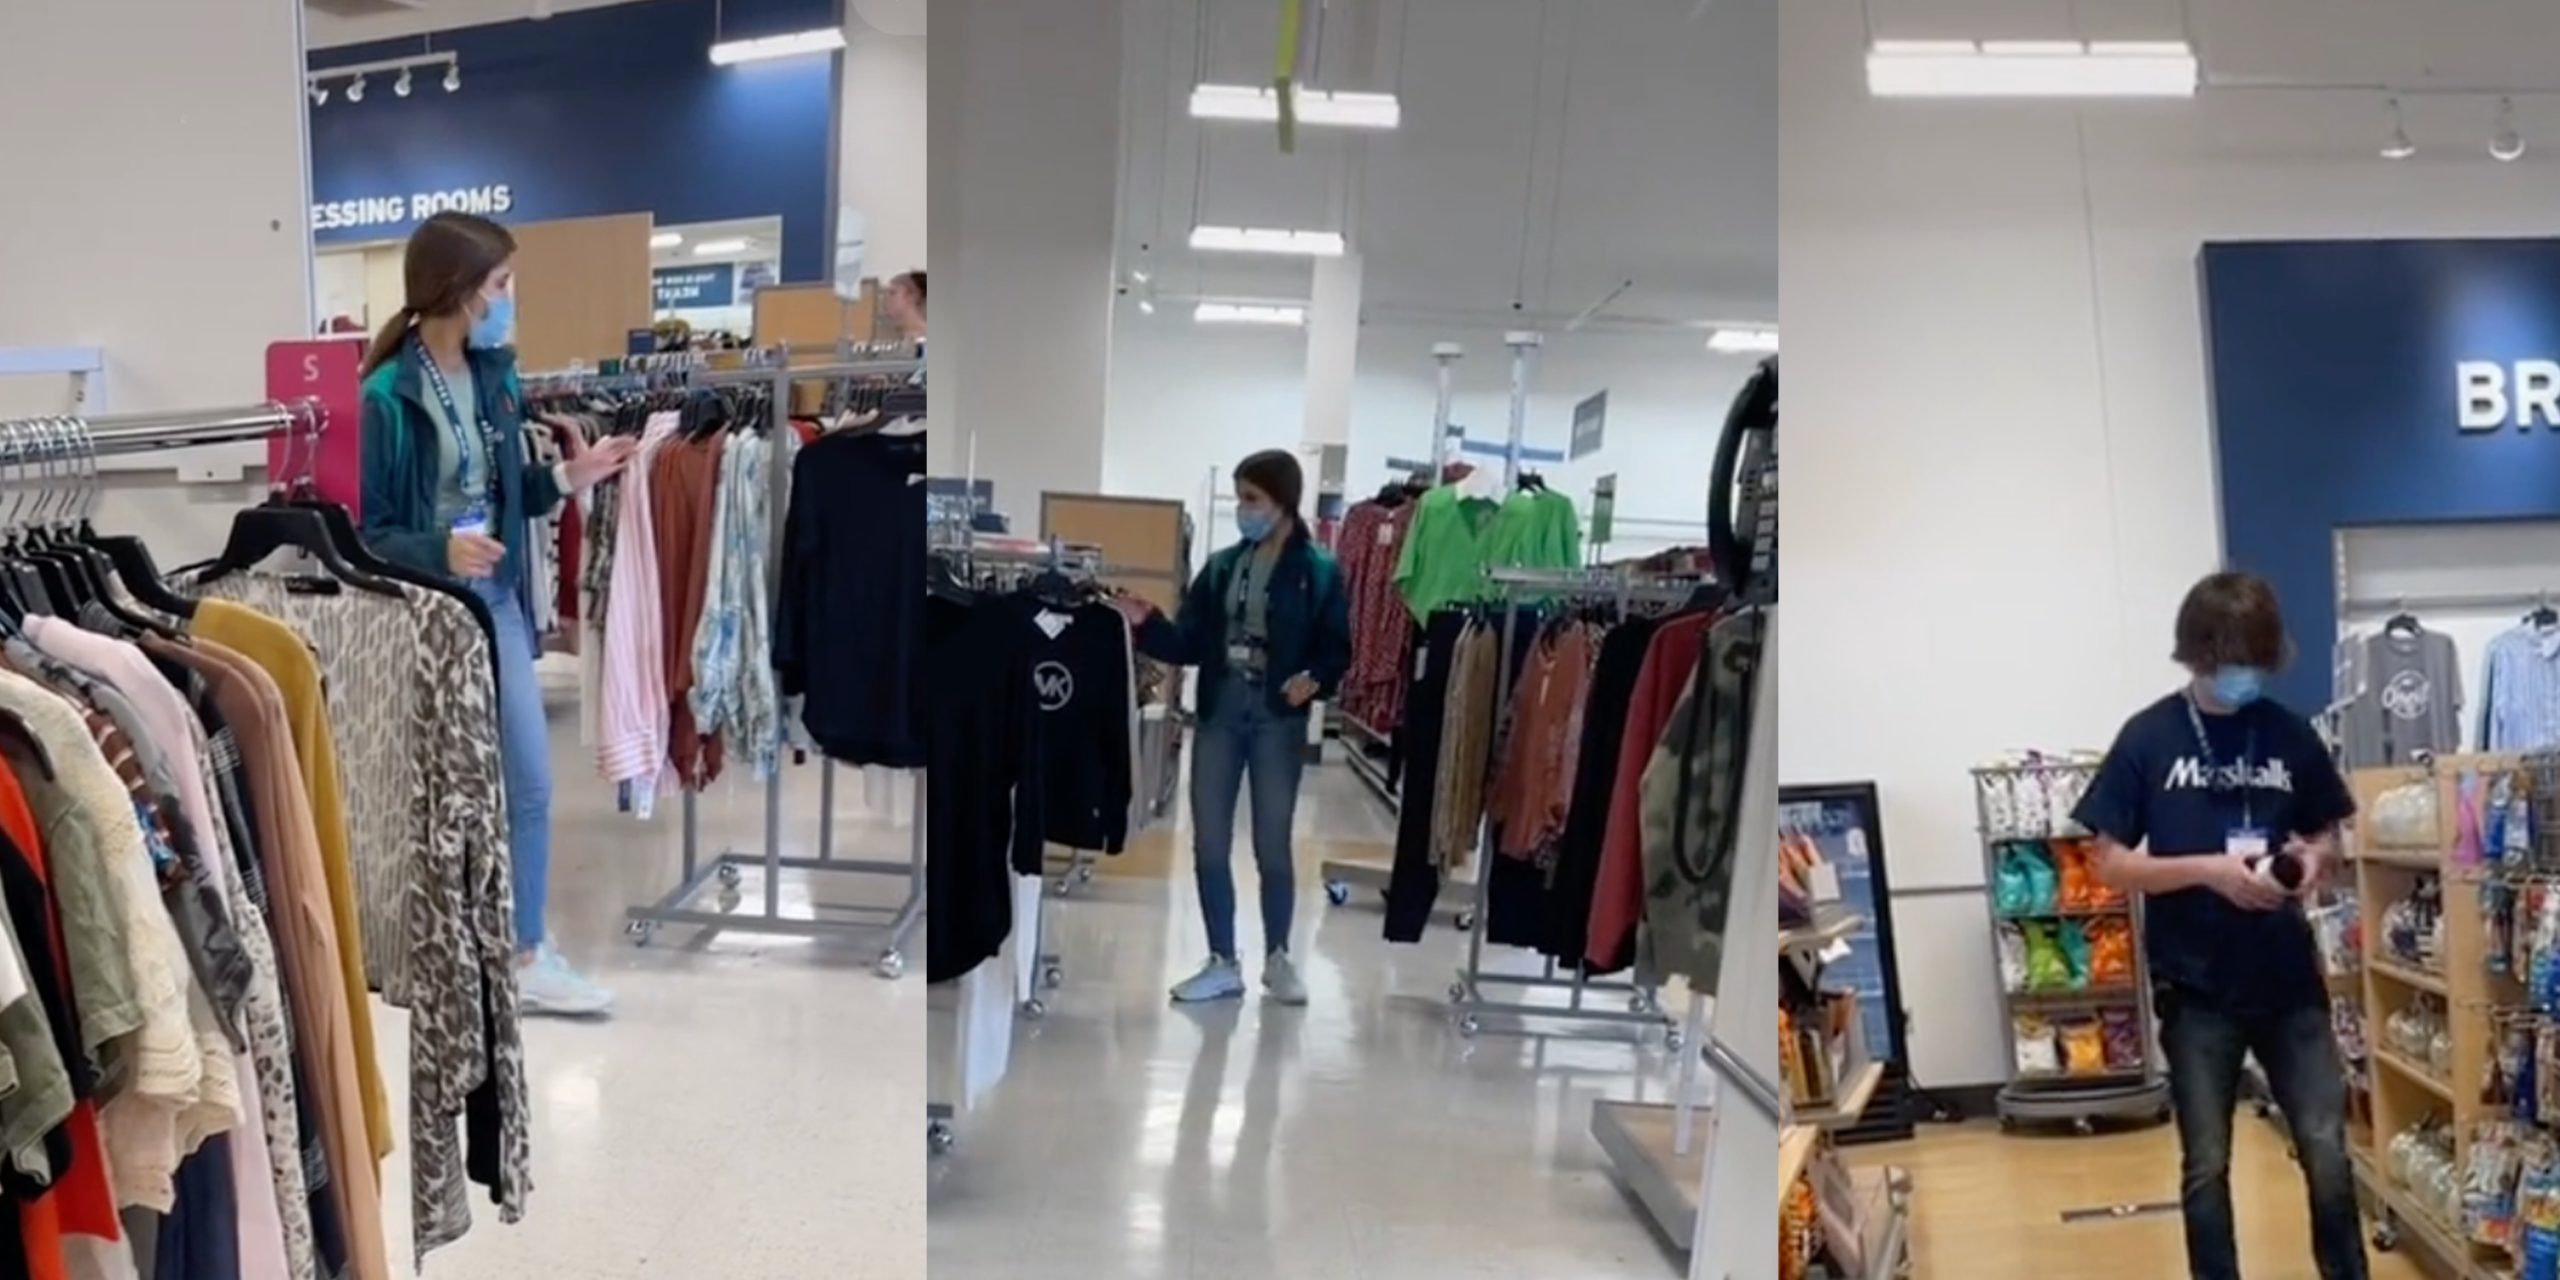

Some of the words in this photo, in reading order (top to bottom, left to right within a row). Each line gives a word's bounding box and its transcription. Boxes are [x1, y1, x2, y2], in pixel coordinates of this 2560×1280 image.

[312, 196, 404, 229] ESSING
[411, 185, 512, 220] ROOMS
[304, 354, 319, 382] S
[2457, 361, 2560, 428] BR
